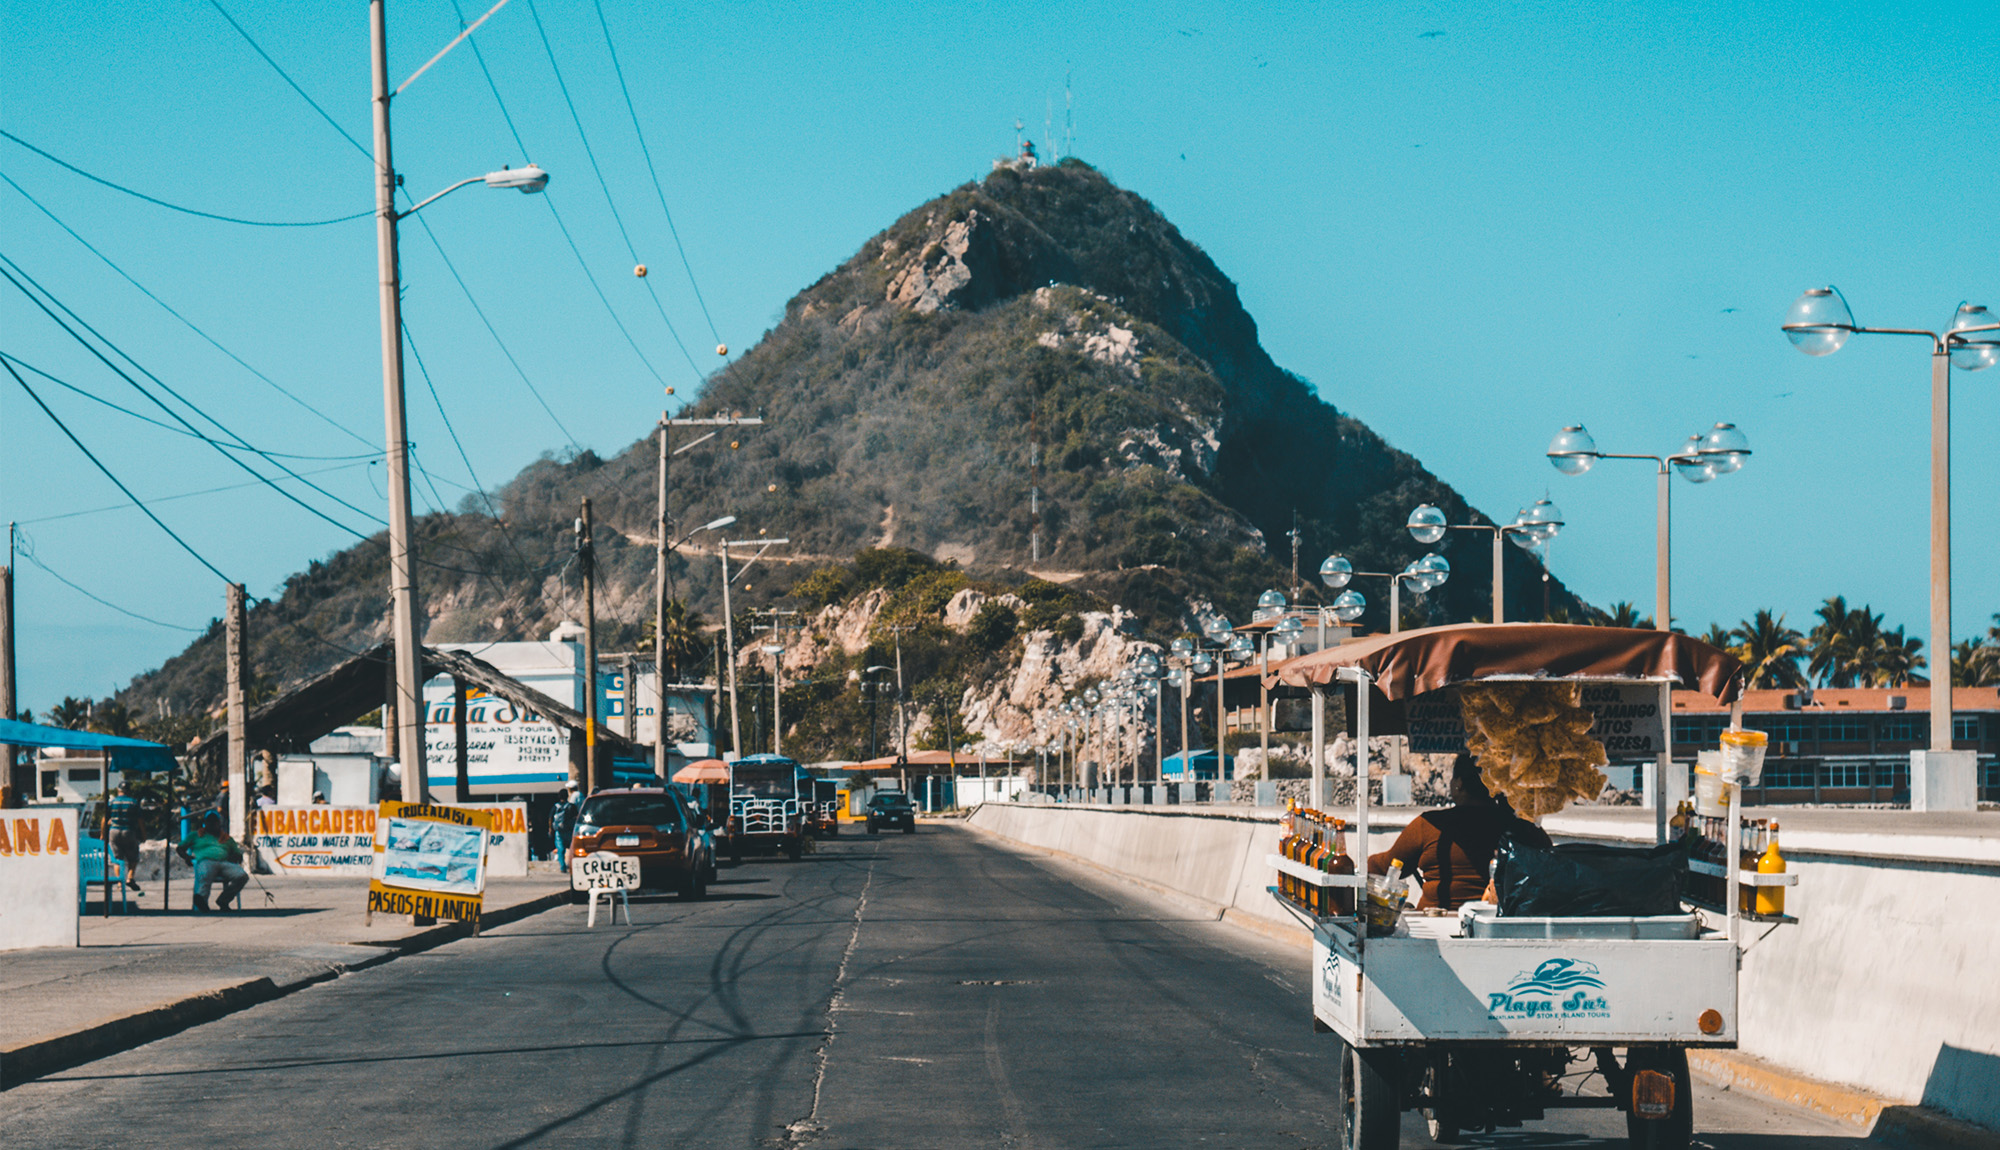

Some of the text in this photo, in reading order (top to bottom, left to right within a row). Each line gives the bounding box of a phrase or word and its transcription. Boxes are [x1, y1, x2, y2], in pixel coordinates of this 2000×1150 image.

[1605, 736, 1652, 750] FRESA
[398, 804, 428, 818] CRUCE
[438, 806, 450, 820] LA
[452, 810, 472, 826] ISLA
[256, 836, 283, 848] STONE
[287, 836, 318, 848] ISLAND
[321, 836, 350, 848] WATER
[353, 836, 374, 848] TAXI
[290, 855, 373, 866] ESTACIONAMIENTO
[583, 860, 628, 875] CRUCE
[368, 890, 482, 923] PASEOS EN LANCHA
[1488, 992, 1609, 1018] Playa Sur
